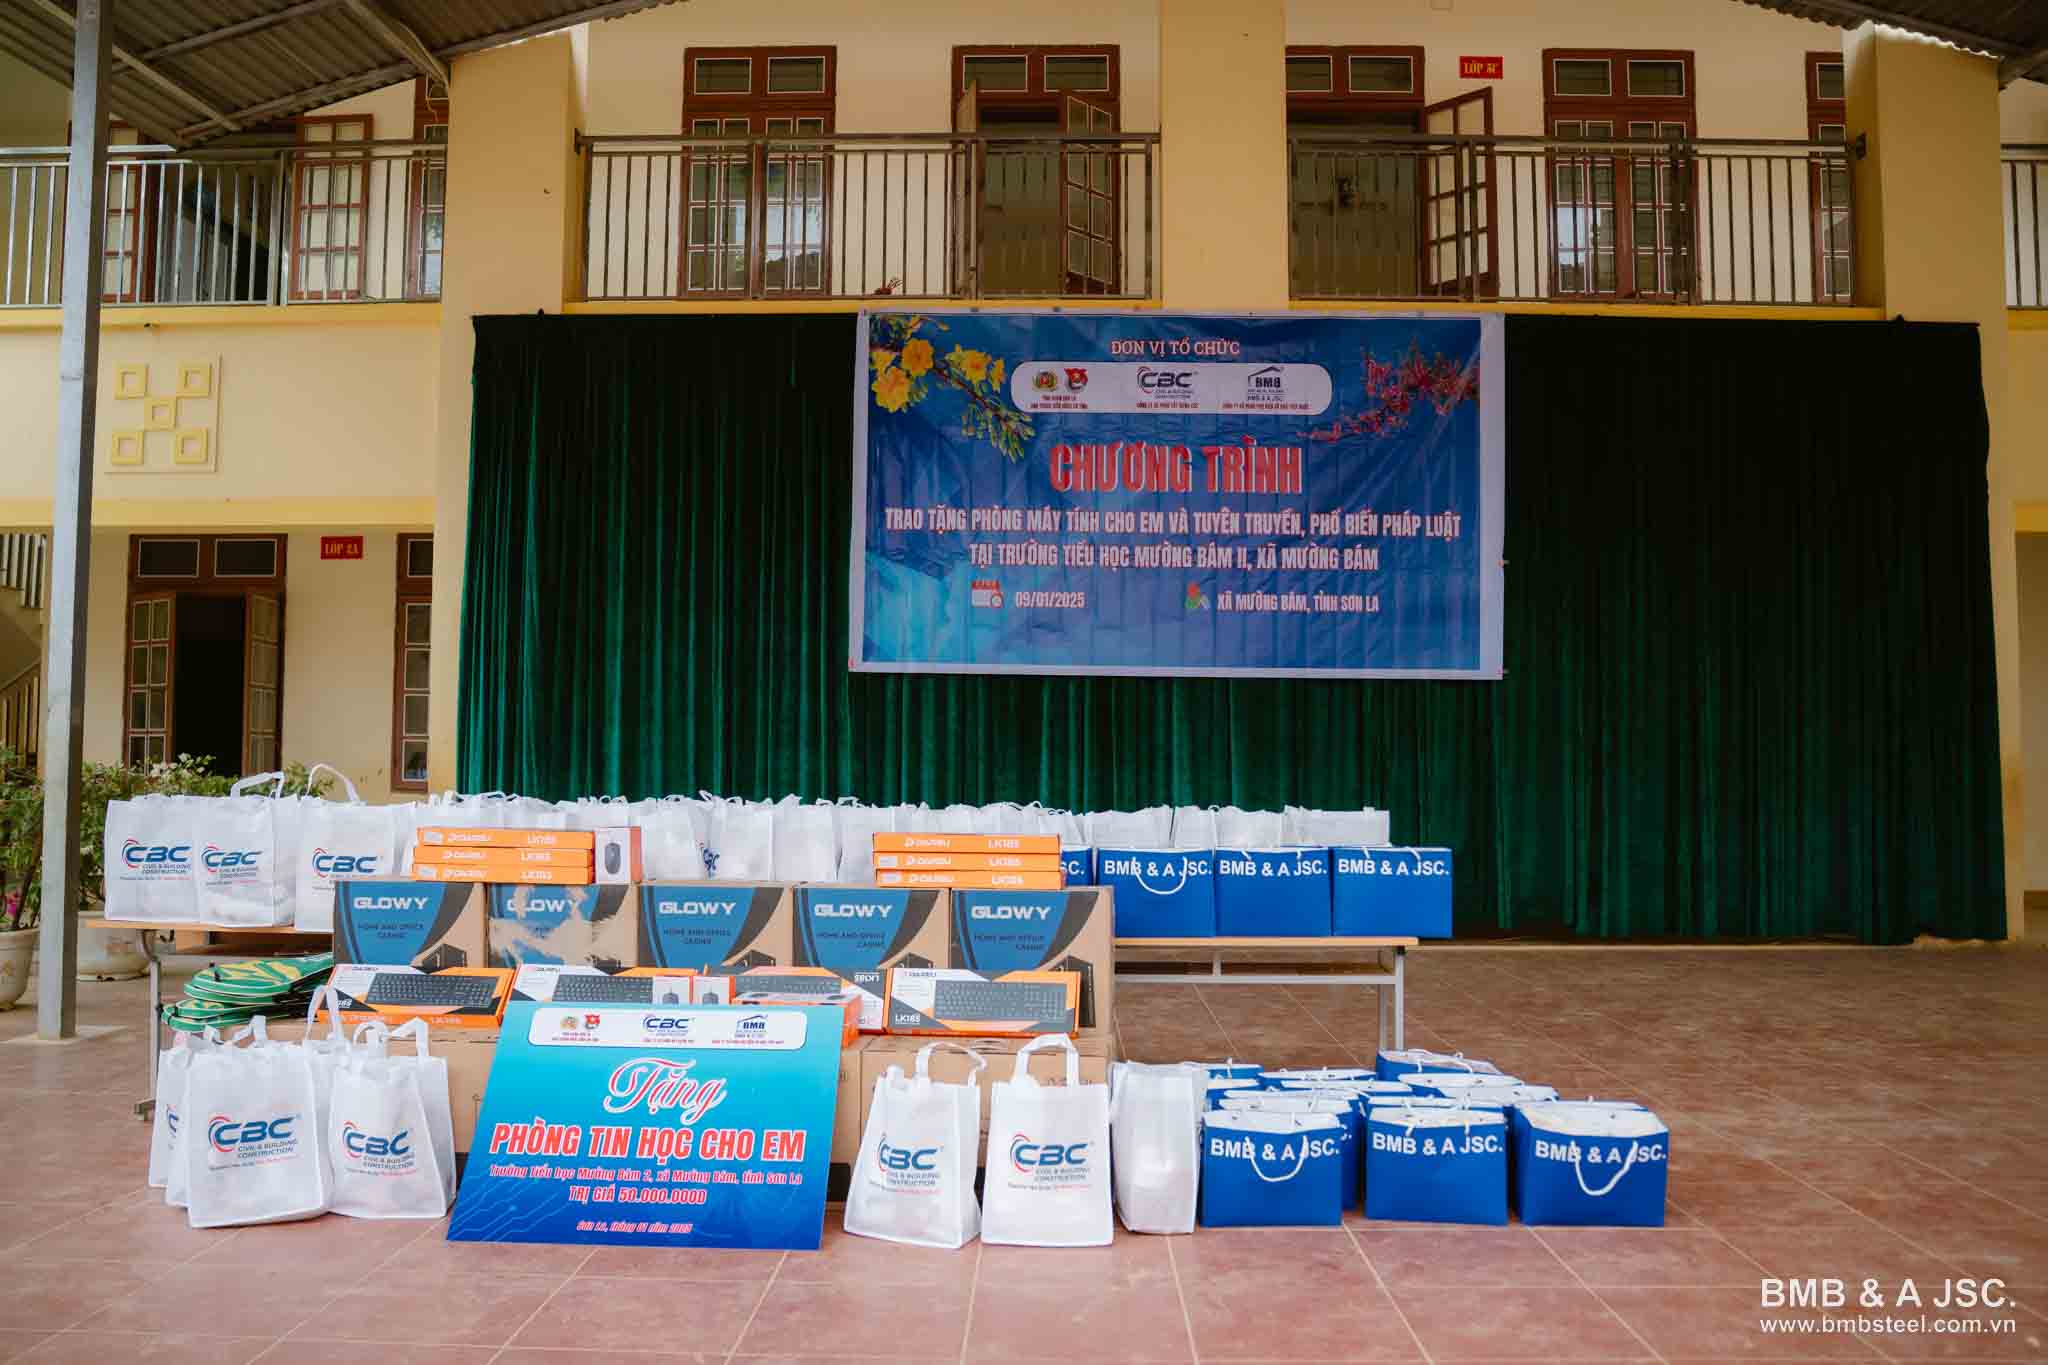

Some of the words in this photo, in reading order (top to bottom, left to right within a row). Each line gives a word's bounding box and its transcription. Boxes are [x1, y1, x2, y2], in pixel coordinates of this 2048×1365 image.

[1111, 339, 1145, 354] ĐƠN
[1150, 340, 1166, 357] VỊ
[1169, 336, 1190, 355] TỔ
[1194, 338, 1240, 355] CHỨC
[1140, 371, 1192, 388] CBC
[1255, 376, 1281, 388] BMB
[1050, 440, 1192, 492] CHƯƠNG
[1202, 434, 1302, 493] TRÌNH
[885, 508, 922, 530] TRAO
[928, 504, 967, 535] TẶNG
[971, 505, 1023, 531] PHÒNG
[1027, 506, 1061, 531] MÁY
[1066, 507, 1099, 532] TÍNH
[1104, 511, 1135, 533] CHO
[1140, 511, 1164, 533] EM
[1168, 508, 1189, 534] VÀ
[1194, 507, 1239, 534] TUYÊN
[1382, 510, 1421, 536] PHÁP
[1425, 512, 1461, 542] LUẬT
[969, 543, 993, 568] TẠI
[997, 539, 1058, 566] TRƯỜNG
[1099, 545, 1130, 572] HỌC
[1134, 541, 1192, 568] MƯỜNG
[1256, 543, 1277, 568] XÃ
[1281, 542, 1339, 569] MƯỜNG
[1344, 544, 1379, 570] BÁM
[1015, 591, 1086, 608] 09/01/2025
[1217, 591, 1233, 611] XÃ
[1235, 590, 1278, 611] MƯỜNG
[1340, 592, 1363, 612] SƠN
[1365, 594, 1379, 612] LA
[126, 845, 192, 863] CBC
[205, 850, 262, 867] CBC
[315, 855, 378, 873] CBC
[1104, 860, 1142, 876] BMB
[1147, 861, 1159, 876] &
[1163, 862, 1174, 877] A
[1178, 860, 1212, 876] JSC.
[1219, 859, 1256, 876] BMB
[1262, 862, 1274, 876] &
[1277, 862, 1290, 876] A
[1297, 859, 1327, 876] JSC.
[1338, 858, 1375, 874] BMB
[1379, 859, 1393, 875] &
[1396, 860, 1409, 875] A
[1412, 859, 1450, 876] JSC.
[353, 897, 429, 910] GLOWY
[658, 902, 736, 915] GLOWY
[814, 903, 892, 918] GLOWY
[971, 905, 1051, 920] GLOWY
[646, 1016, 689, 1029] CBC
[743, 1020, 765, 1030] BMB
[895, 1014, 921, 1025] LK185
[603, 1057, 728, 1125] Tặng
[214, 1117, 296, 1145] CBC
[346, 1129, 410, 1156] CBC
[489, 1117, 581, 1154] PHÒNG
[588, 1126, 631, 1157] TIN
[636, 1128, 692, 1166] HỌC
[699, 1130, 754, 1160] CHO
[762, 1130, 806, 1161] EM
[1211, 1138, 1256, 1159] BMB
[1262, 1145, 1276, 1160] &
[1281, 1145, 1295, 1160] A
[1299, 1139, 1340, 1159] JSC.
[1372, 1136, 1416, 1155] BMB
[1423, 1137, 1437, 1155] &
[1441, 1138, 1455, 1154] A
[1459, 1134, 1503, 1155] JSC.
[880, 1144, 938, 1170] CBC
[1015, 1143, 1089, 1166] CBC
[1536, 1141, 1581, 1162] BMB
[1587, 1147, 1602, 1164] &
[1606, 1147, 1621, 1163] A
[1628, 1143, 1666, 1162] JSC.
[554, 1166, 575, 1181] học
[577, 1166, 615, 1181] Mường
[642, 1170, 653, 1182] 2,
[655, 1169, 670, 1182] xã
[789, 1172, 802, 1184] La
[569, 1185, 590, 1205] TRỊ
[592, 1184, 615, 1202] GIÁ
